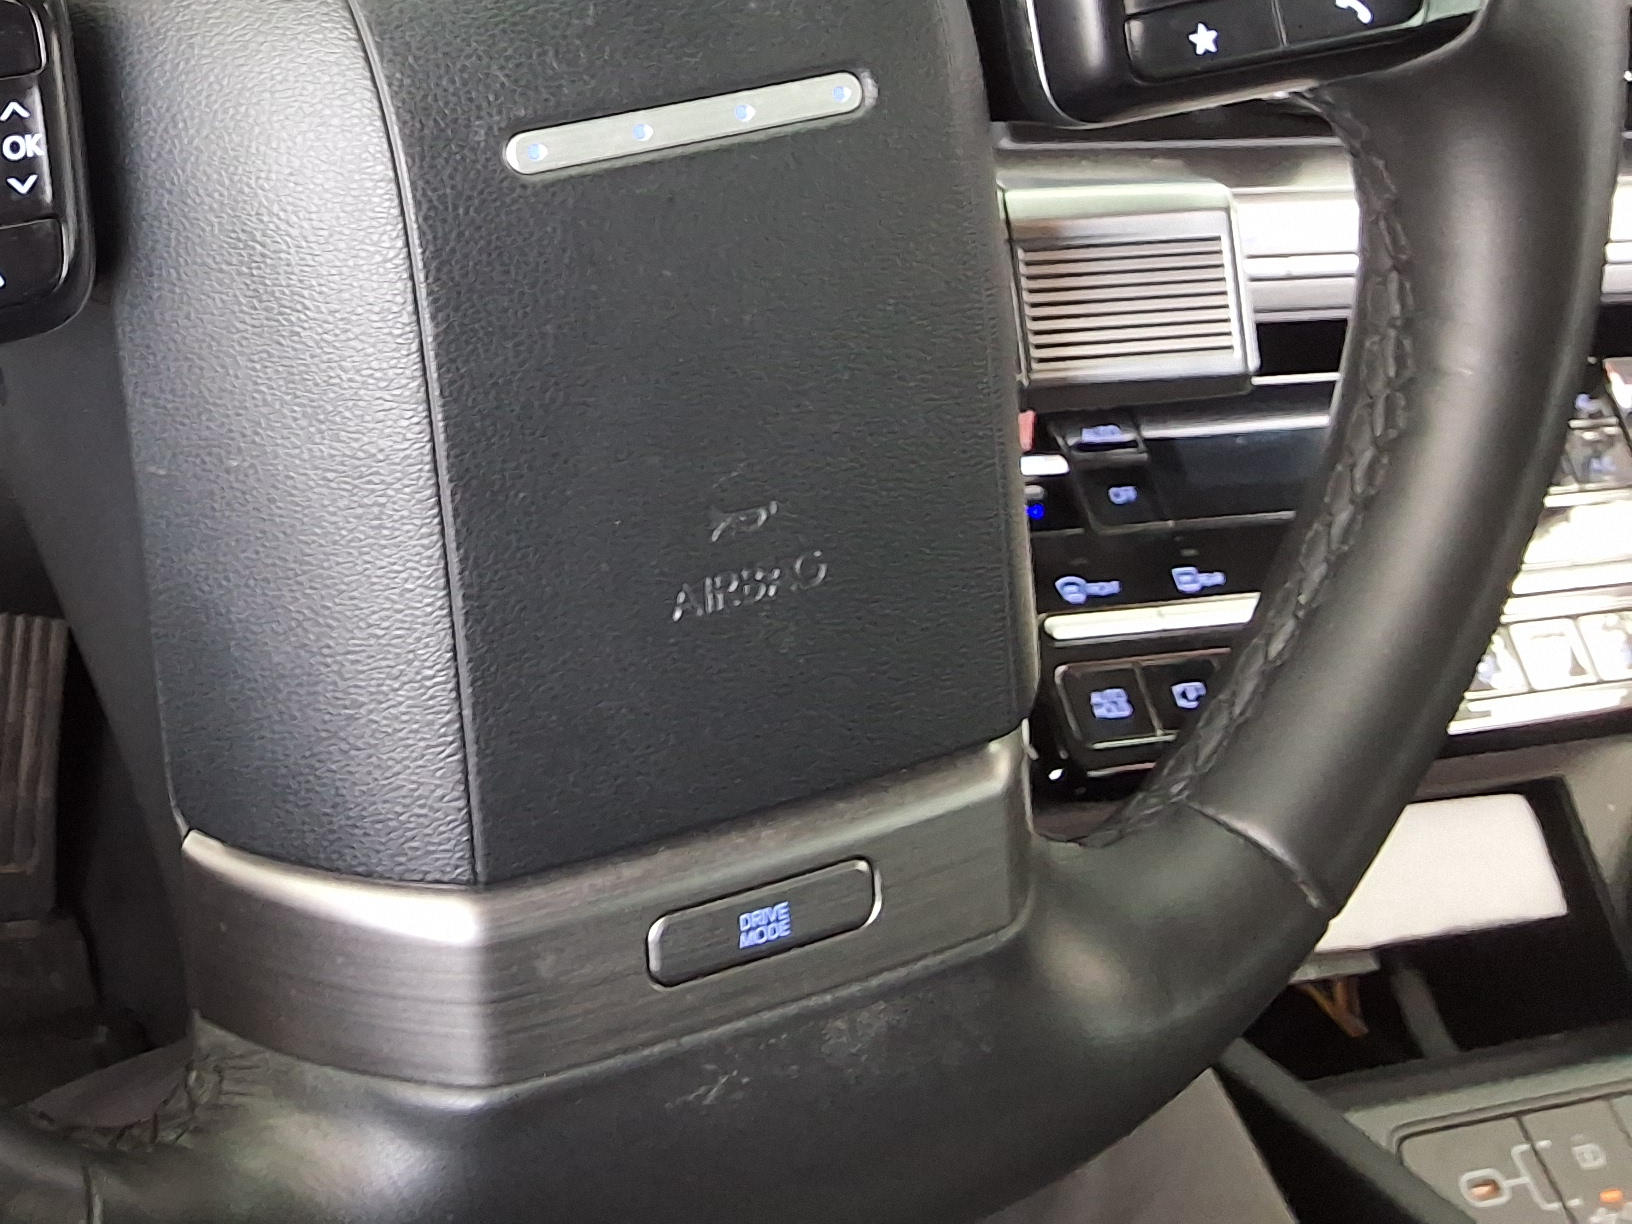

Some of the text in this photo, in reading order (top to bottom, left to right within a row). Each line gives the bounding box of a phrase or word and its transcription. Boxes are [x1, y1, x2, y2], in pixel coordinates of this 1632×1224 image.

[2, 133, 45, 162] OK
[672, 550, 828, 622] AIRBAG
[739, 901, 790, 931] DRIVE
[739, 919, 791, 949] MODE
